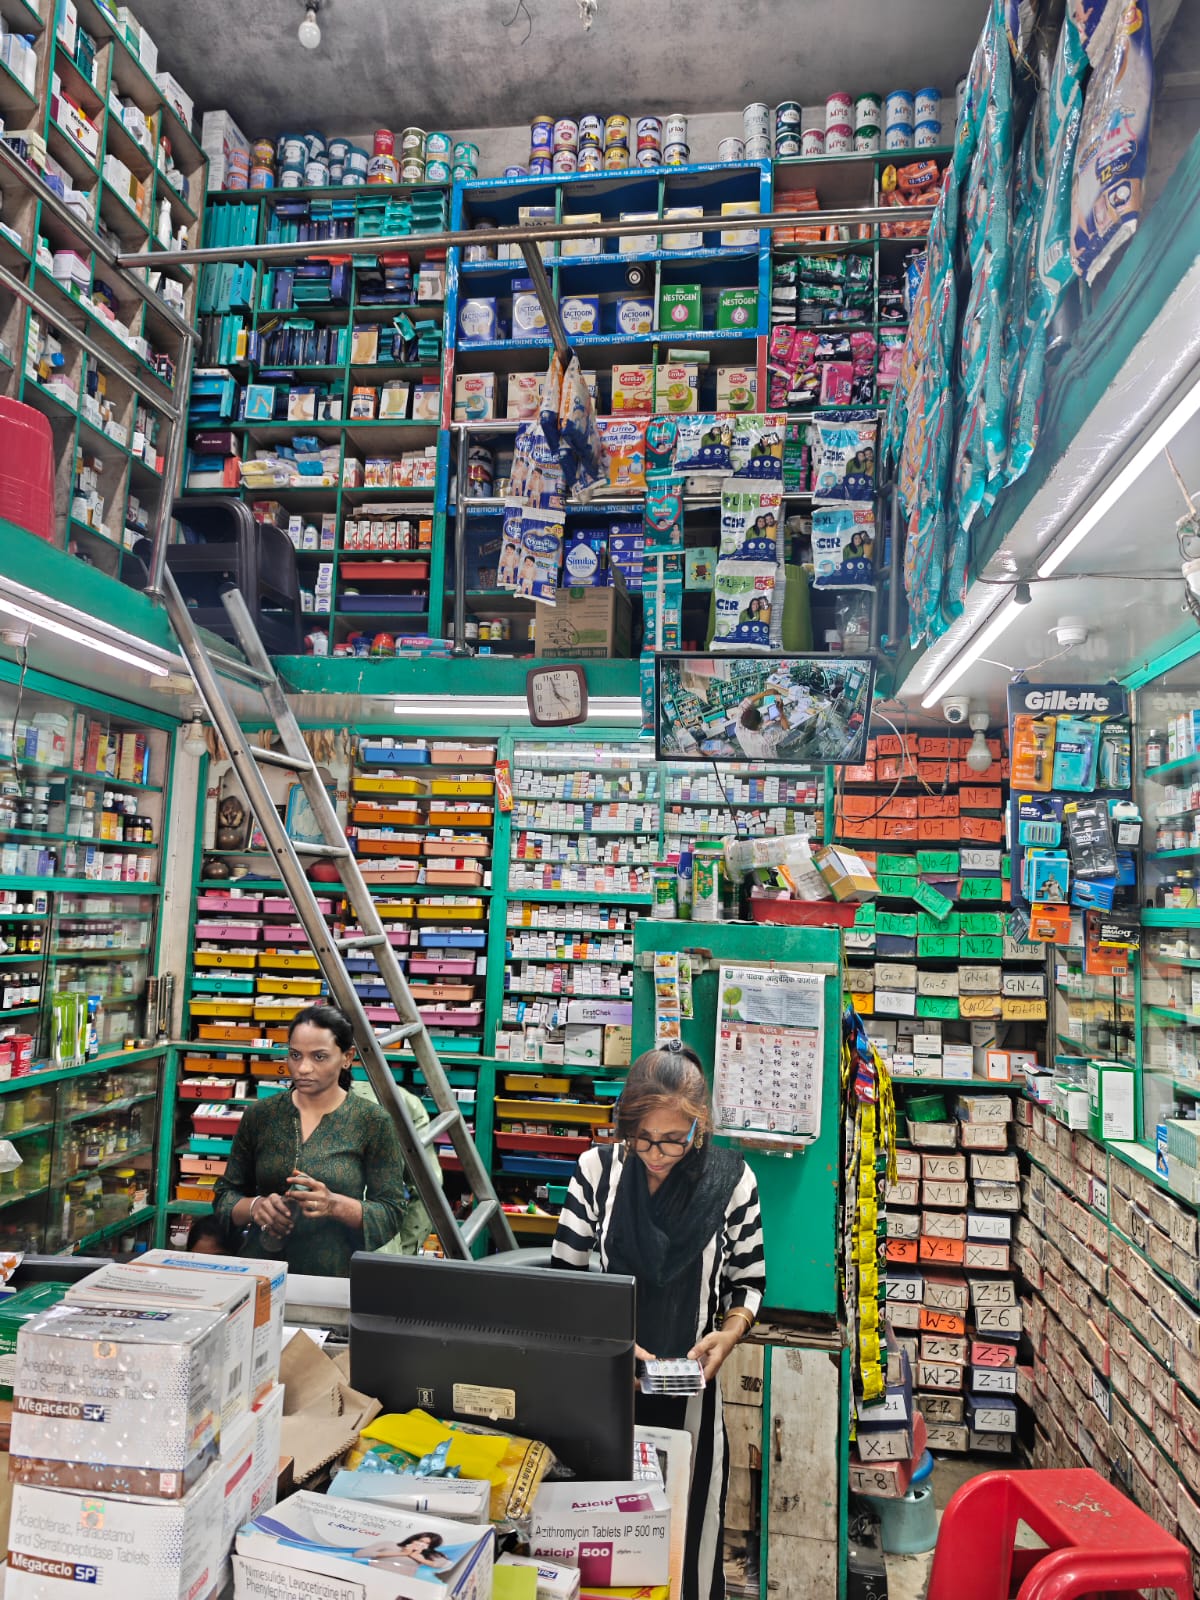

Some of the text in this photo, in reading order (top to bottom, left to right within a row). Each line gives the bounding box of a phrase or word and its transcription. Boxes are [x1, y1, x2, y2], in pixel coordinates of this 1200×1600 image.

[663, 293, 697, 302] NESTOGEN
[723, 298, 757, 307] NESTOGEN
[563, 310, 593, 319] LACTOGEN
[622, 310, 650, 321] LACTOGEN
[573, 321, 578, 330] 3
[631, 323, 636, 331] 4
[576, 336, 610, 344] NUTRITION
[723, 516, 746, 528] CIR
[817, 538, 841, 550] CIR
[566, 556, 597, 566] Similac
[716, 599, 739, 611] CIR
[553, 673, 561, 681] 12
[535, 683, 543, 691] 10
[1025, 691, 1109, 711] Gillette
[924, 740, 946, 753] B-1
[457, 754, 464, 762] A
[920, 765, 943, 777] D-1
[968, 791, 989, 804] N-1
[940, 855, 953, 870] 4
[985, 854, 995, 866] 5
[897, 879, 904, 893] 1
[982, 880, 993, 896] 7
[936, 938, 945, 954] 9
[979, 939, 995, 954] 12
[1005, 979, 1041, 992] GN-4
[939, 999, 952, 1012] 2
[278, 1066, 285, 1075] S
[976, 1104, 1003, 1116] T-22
[928, 1159, 959, 1175] V-6
[928, 1185, 961, 1204] V-11
[981, 1189, 1013, 1203] V-5
[926, 1218, 960, 1234] X-4
[927, 1243, 953, 1257] Y-1
[968, 1249, 1003, 1266] X-2
[886, 1282, 916, 1300] Z-9
[977, 1285, 1012, 1302] Z-15
[926, 1311, 957, 1330] W-3
[980, 1309, 1011, 1327] Z-6
[927, 1342, 959, 1357] Z-3
[977, 1346, 1010, 1364] Z-5
[923, 1369, 960, 1385] W-2
[978, 1374, 1013, 1390] Z-11
[18, 1397, 104, 1421] Megaceclo SP
[928, 1429, 956, 1443] Z-2
[866, 1439, 895, 1456] X-1
[853, 1472, 888, 1490] T-8
[571, 1495, 649, 1510] Azicip 500
[77, 1525, 136, 1544] Paracetamol
[535, 1525, 665, 1541] Azithromycin Tablets IP 500 mg
[14, 1533, 31, 1546] and
[117, 1548, 150, 1566] Tablets
[534, 1547, 575, 1559] Azicip
[581, 1547, 610, 1558] 500
[12, 1554, 95, 1581] Megaceclo SP
[245, 1564, 288, 1586] Nimesulide,
[289, 1577, 340, 1599] Levocetirizine
